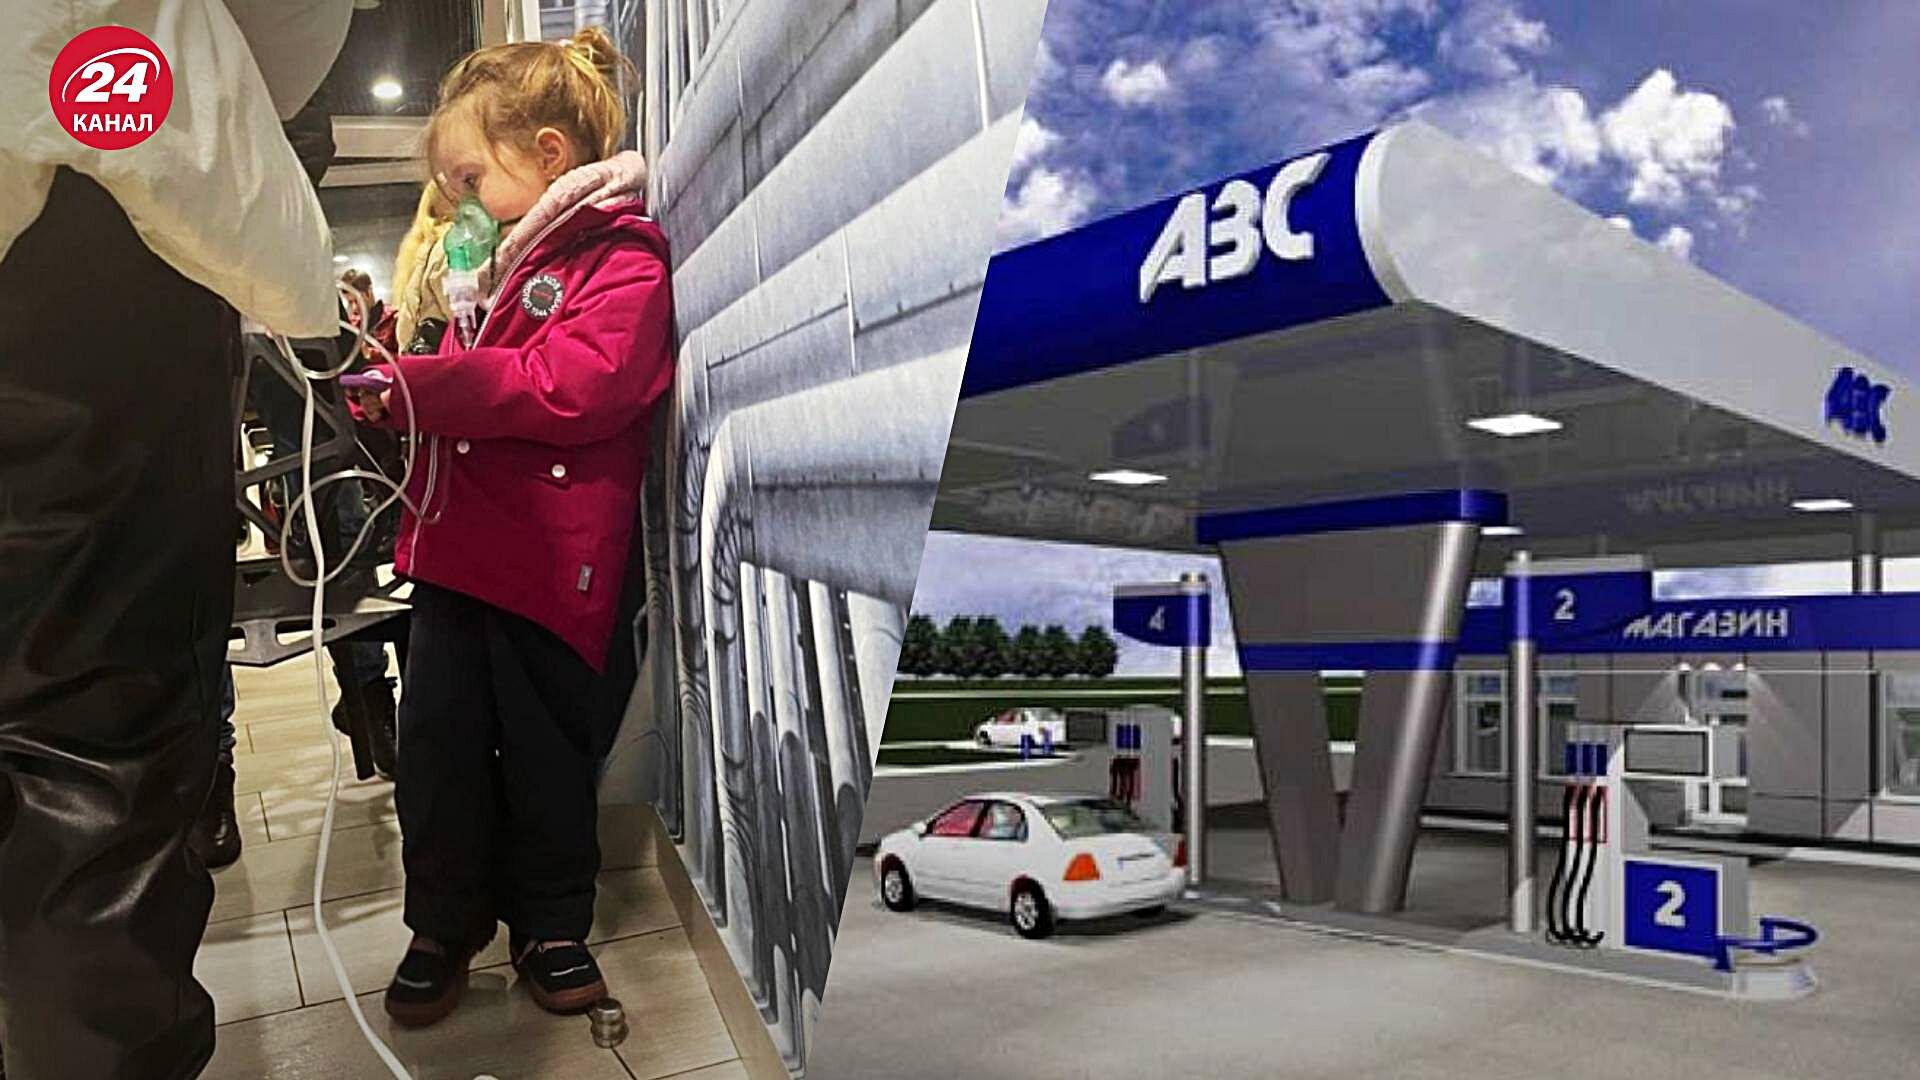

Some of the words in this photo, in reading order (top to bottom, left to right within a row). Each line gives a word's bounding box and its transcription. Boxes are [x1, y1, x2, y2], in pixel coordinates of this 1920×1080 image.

[1139, 152, 1331, 303] АЗС
[1825, 367, 1891, 443] АЗС
[1148, 606, 1166, 632] 4
[1554, 588, 1575, 620] 2
[1654, 880, 1686, 927] 2
